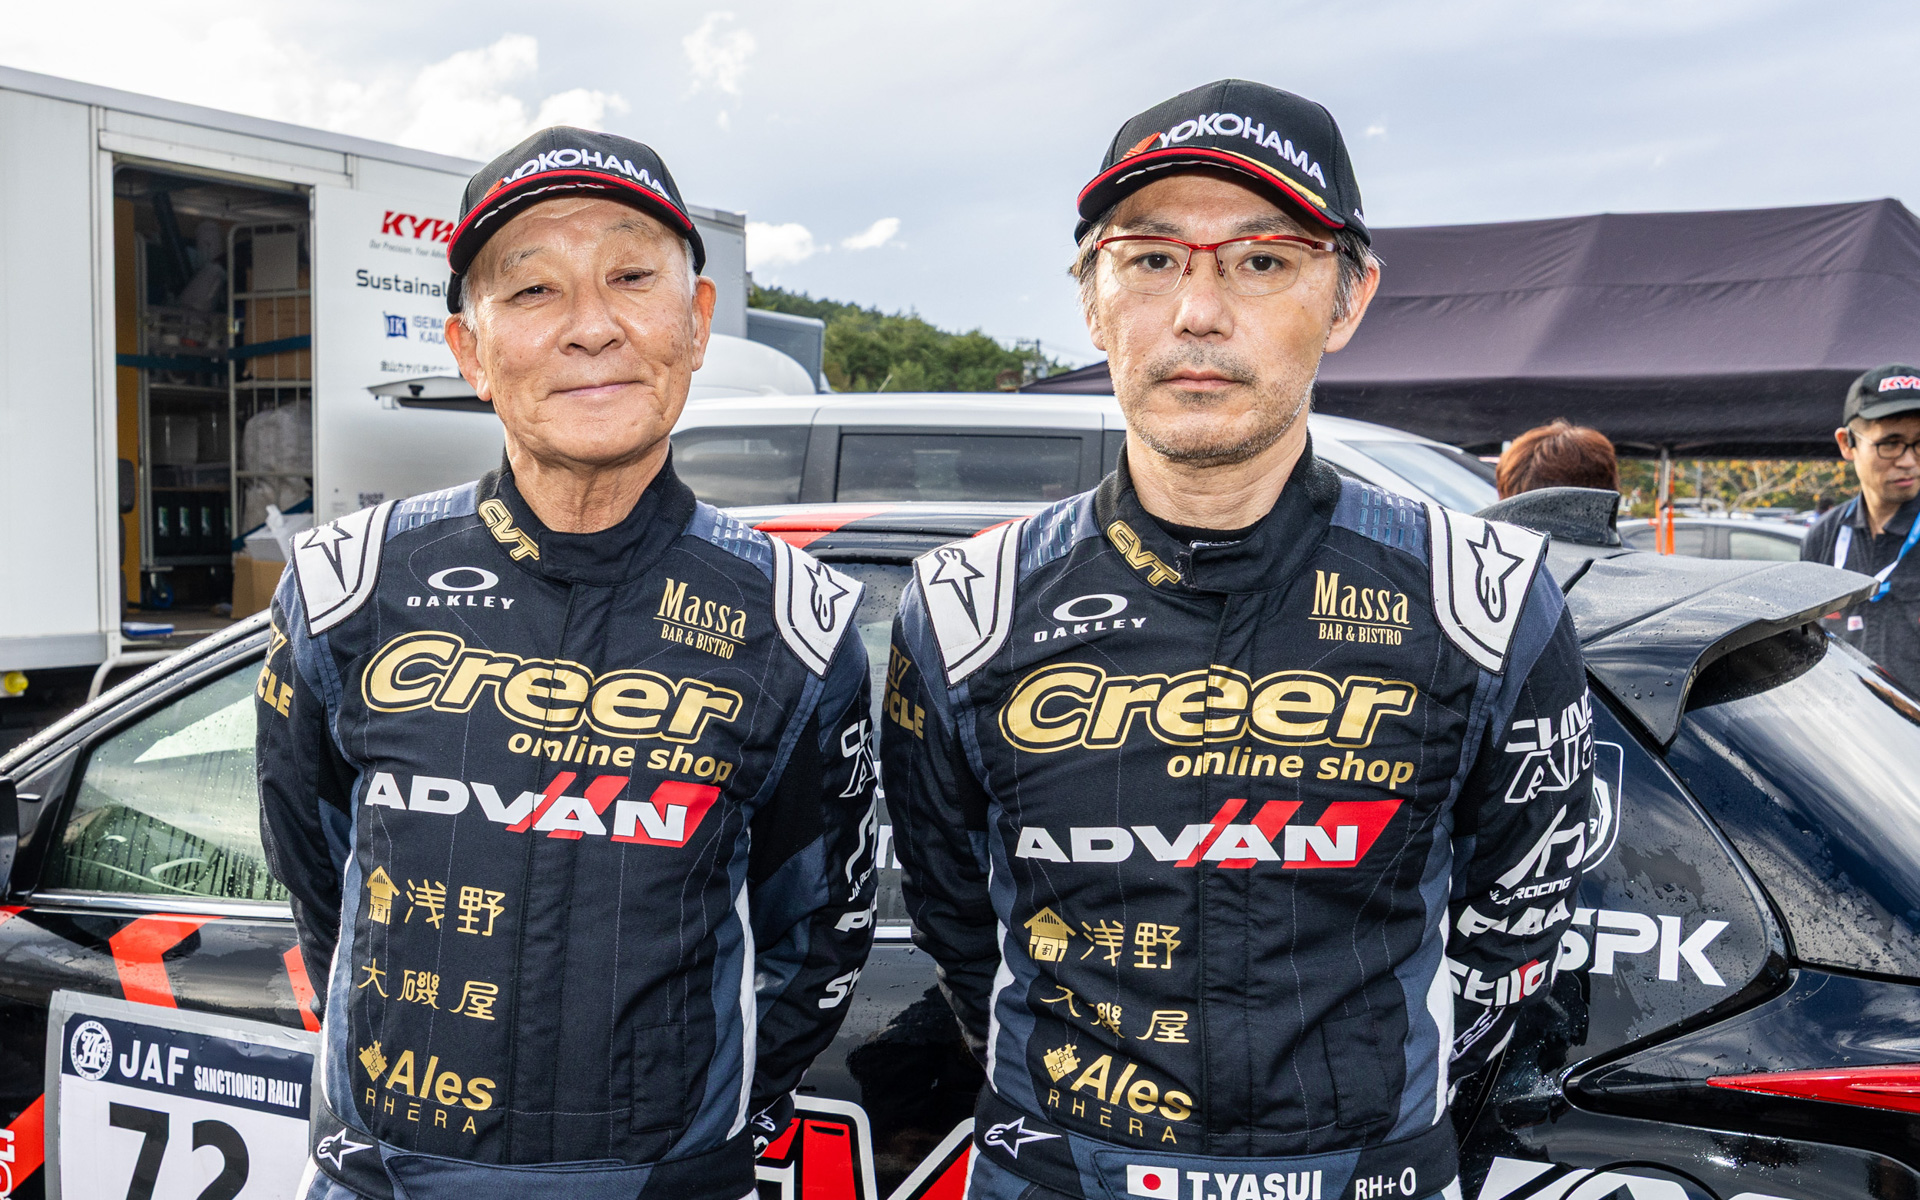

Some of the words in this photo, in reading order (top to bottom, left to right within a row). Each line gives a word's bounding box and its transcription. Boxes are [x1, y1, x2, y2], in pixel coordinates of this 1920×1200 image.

[502, 149, 671, 201] YOKOHAMA
[1159, 113, 1327, 189] YOKOHAMA
[407, 595, 515, 609] OAKLEY
[657, 578, 747, 639] Massa
[1311, 569, 1410, 625] Massa
[661, 624, 682, 642] BAR
[685, 631, 694, 645] &
[696, 632, 735, 660] BISTRO
[1034, 617, 1147, 643] OAKLEY
[1318, 623, 1342, 641] BAR
[1346, 628, 1355, 642] &
[1358, 627, 1402, 646] BISTRO
[361, 630, 743, 744] Creer
[998, 662, 1418, 753] Creer
[508, 733, 636, 768] online
[647, 745, 733, 784] shop
[1167, 745, 1304, 777] online
[1317, 751, 1414, 789] shop
[364, 772, 688, 842] ADVAN
[1015, 824, 1359, 863] ADVAN
[404, 877, 506, 937] 浅野
[1080, 919, 1182, 970] 浅野
[119, 1040, 189, 1086] JAF
[194, 1065, 266, 1102] SANCTIONED
[267, 1079, 303, 1108] RALLY
[385, 1049, 497, 1111] Ales
[1070, 1054, 1193, 1121] Ales
[109, 1101, 250, 1200] 72
[1187, 1170, 1323, 1200] T.YASUI
